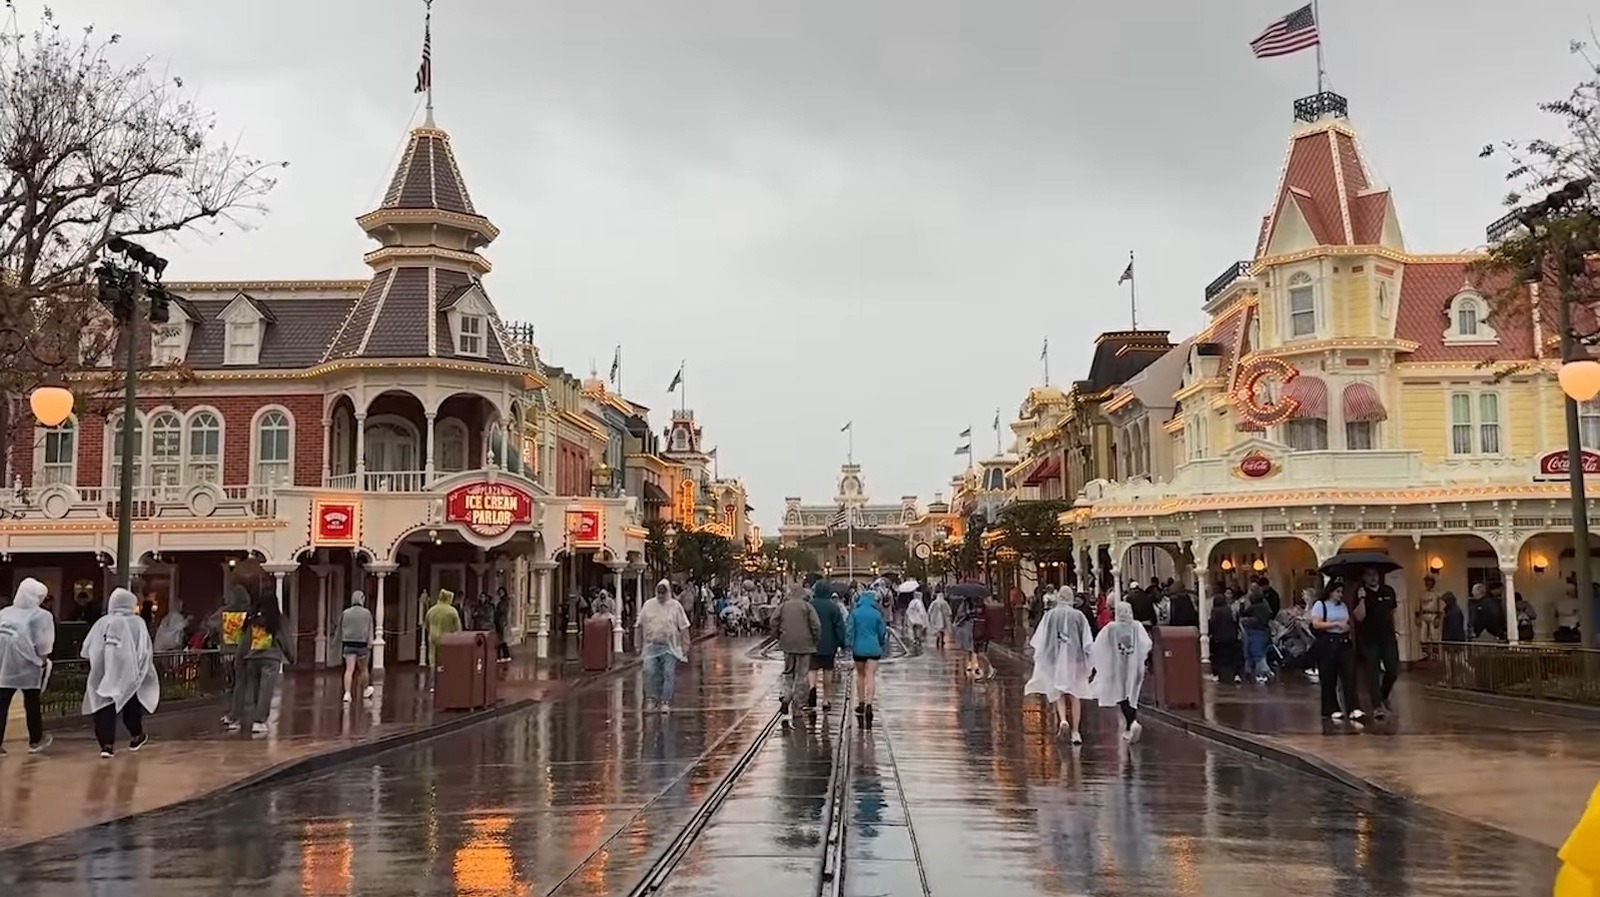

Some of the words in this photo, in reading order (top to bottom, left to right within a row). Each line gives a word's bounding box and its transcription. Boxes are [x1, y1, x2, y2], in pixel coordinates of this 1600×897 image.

[480, 485, 501, 495] PLAZA
[465, 495, 482, 509] ICE
[484, 495, 518, 511] CREAM
[472, 510, 511, 525] PARLOR
